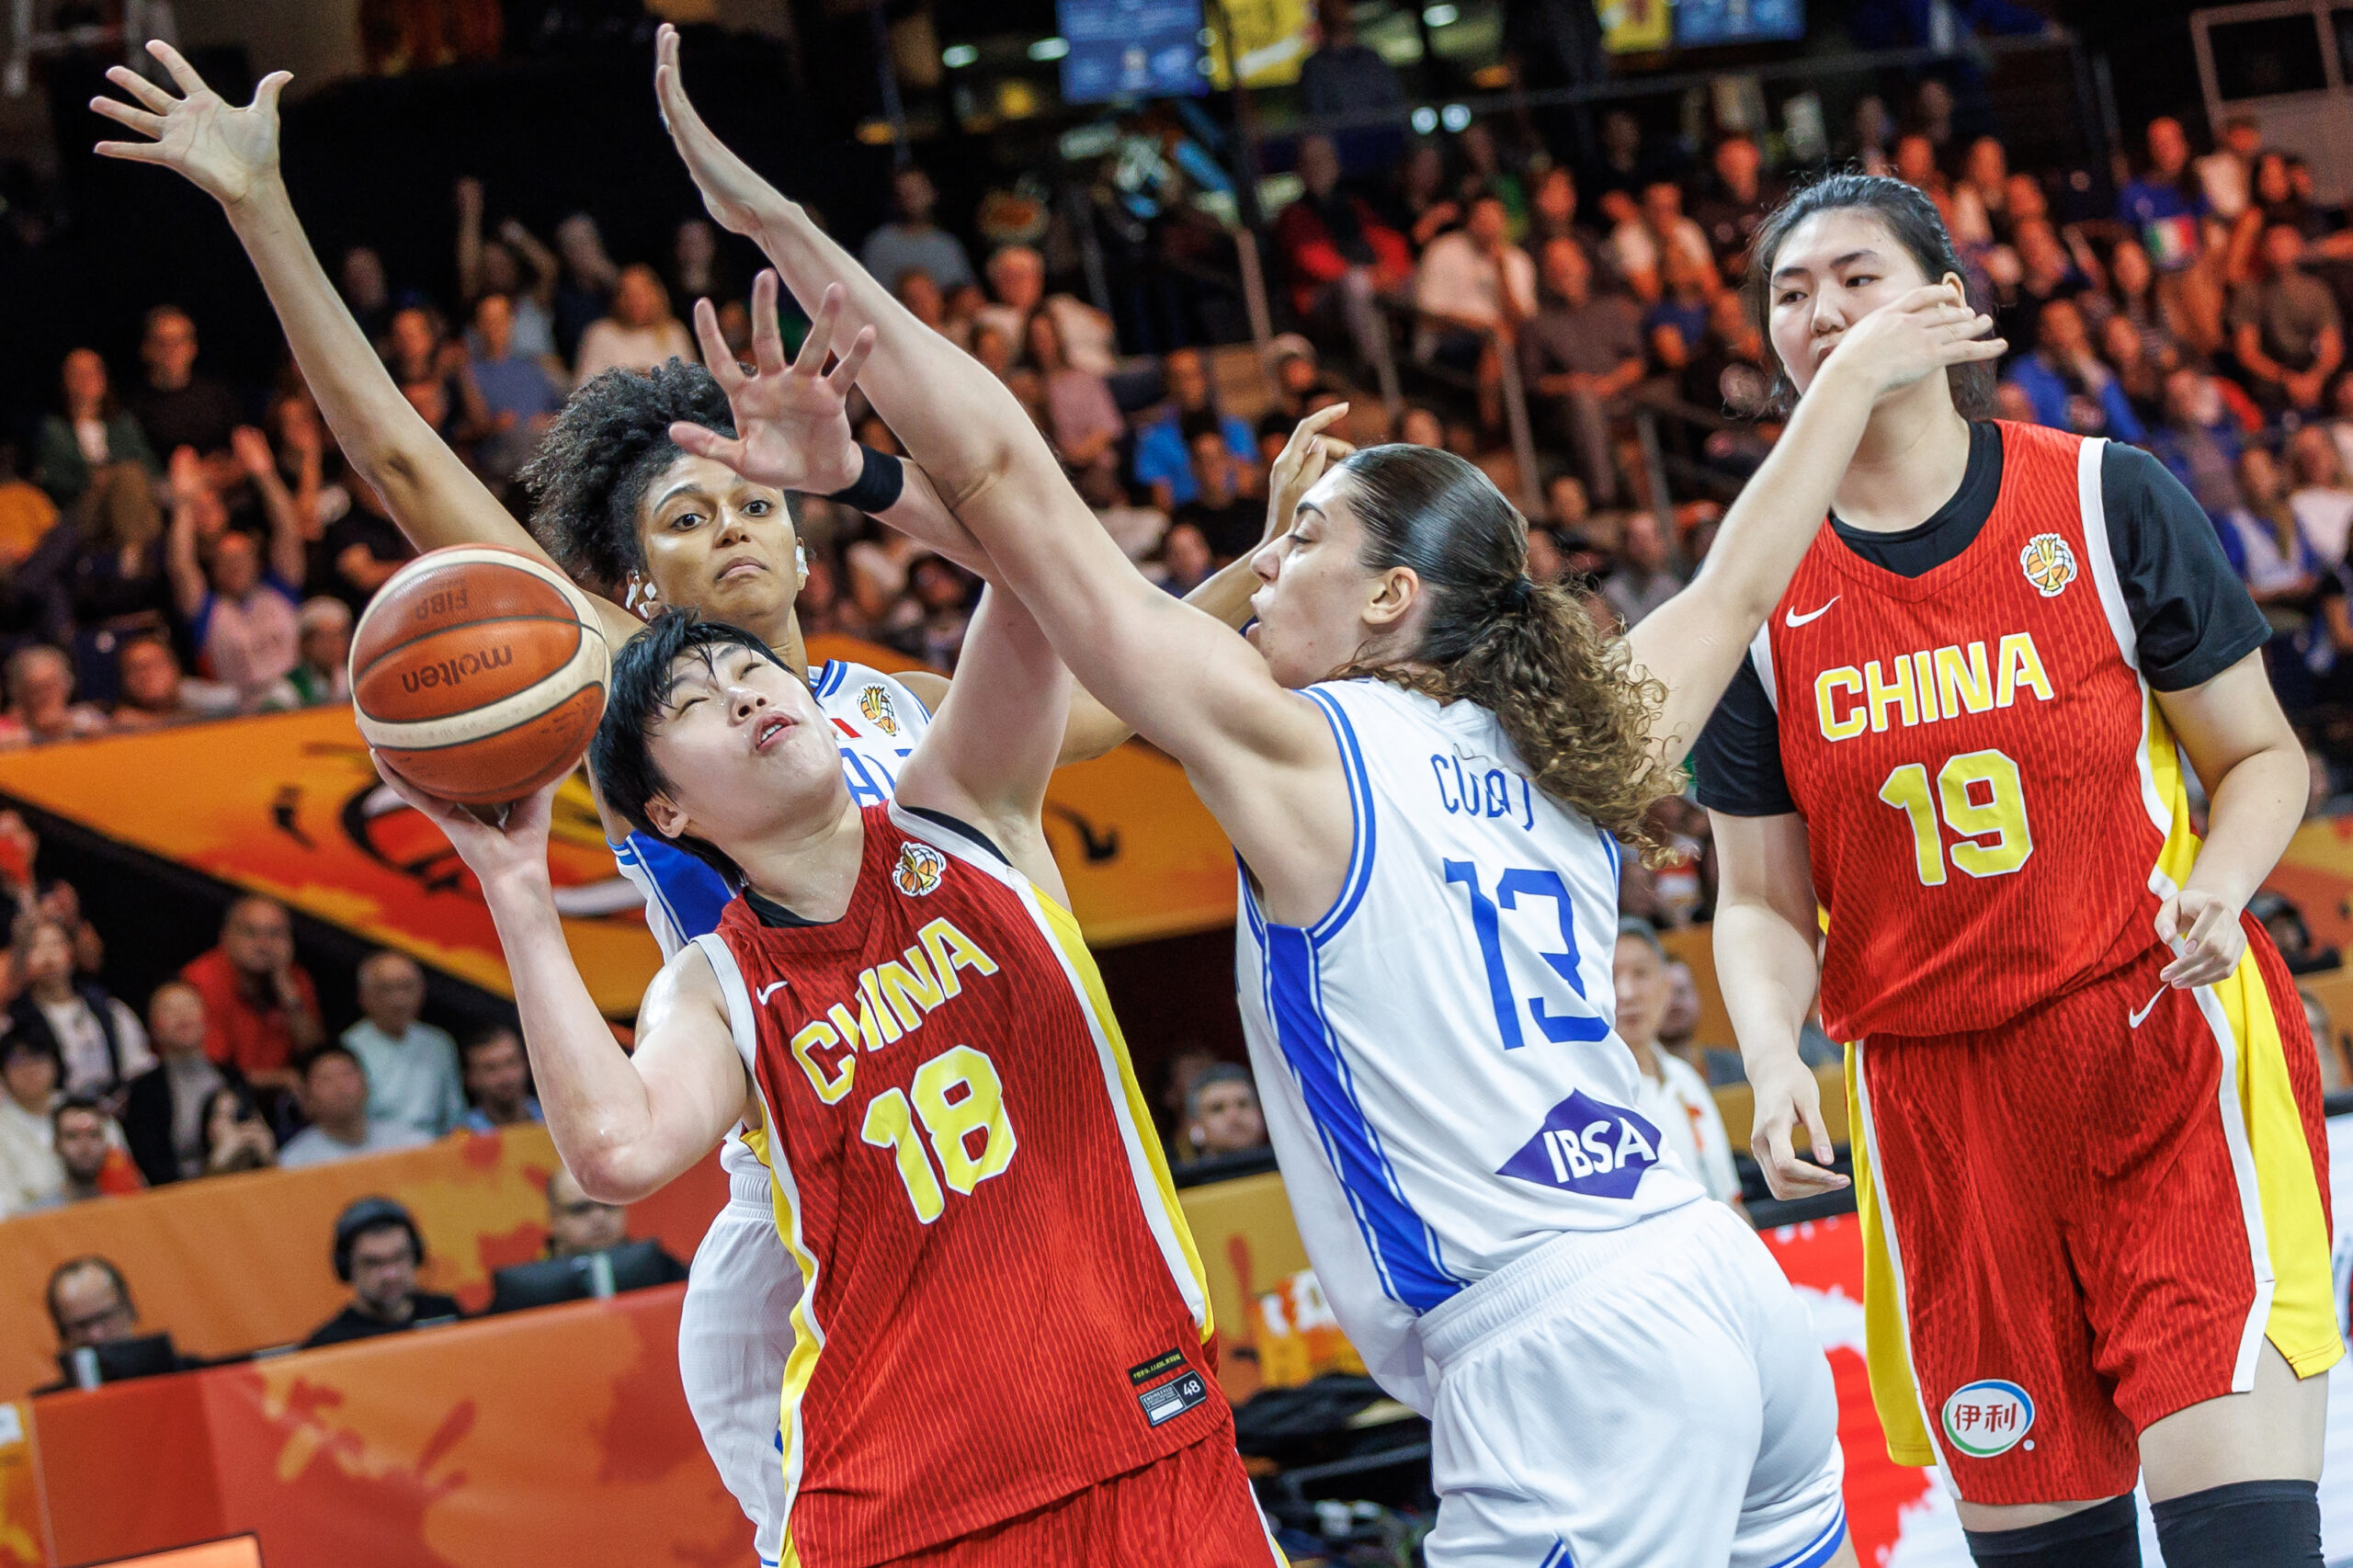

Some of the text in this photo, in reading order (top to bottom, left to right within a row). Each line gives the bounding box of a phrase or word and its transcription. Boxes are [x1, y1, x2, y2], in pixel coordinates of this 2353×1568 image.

[415, 589, 469, 620] FIBA
[402, 644, 513, 693] molten
[1813, 631, 2055, 743] CHINA
[1878, 748, 2034, 887] 19
[1443, 857, 1610, 1051] 13
[790, 916, 999, 1106] CHINA
[860, 1044, 1017, 1225] 18
[1542, 1117, 1657, 1184] IBSA
[1183, 1380, 1201, 1396] 48
[1953, 1403, 2018, 1433] 伊利
